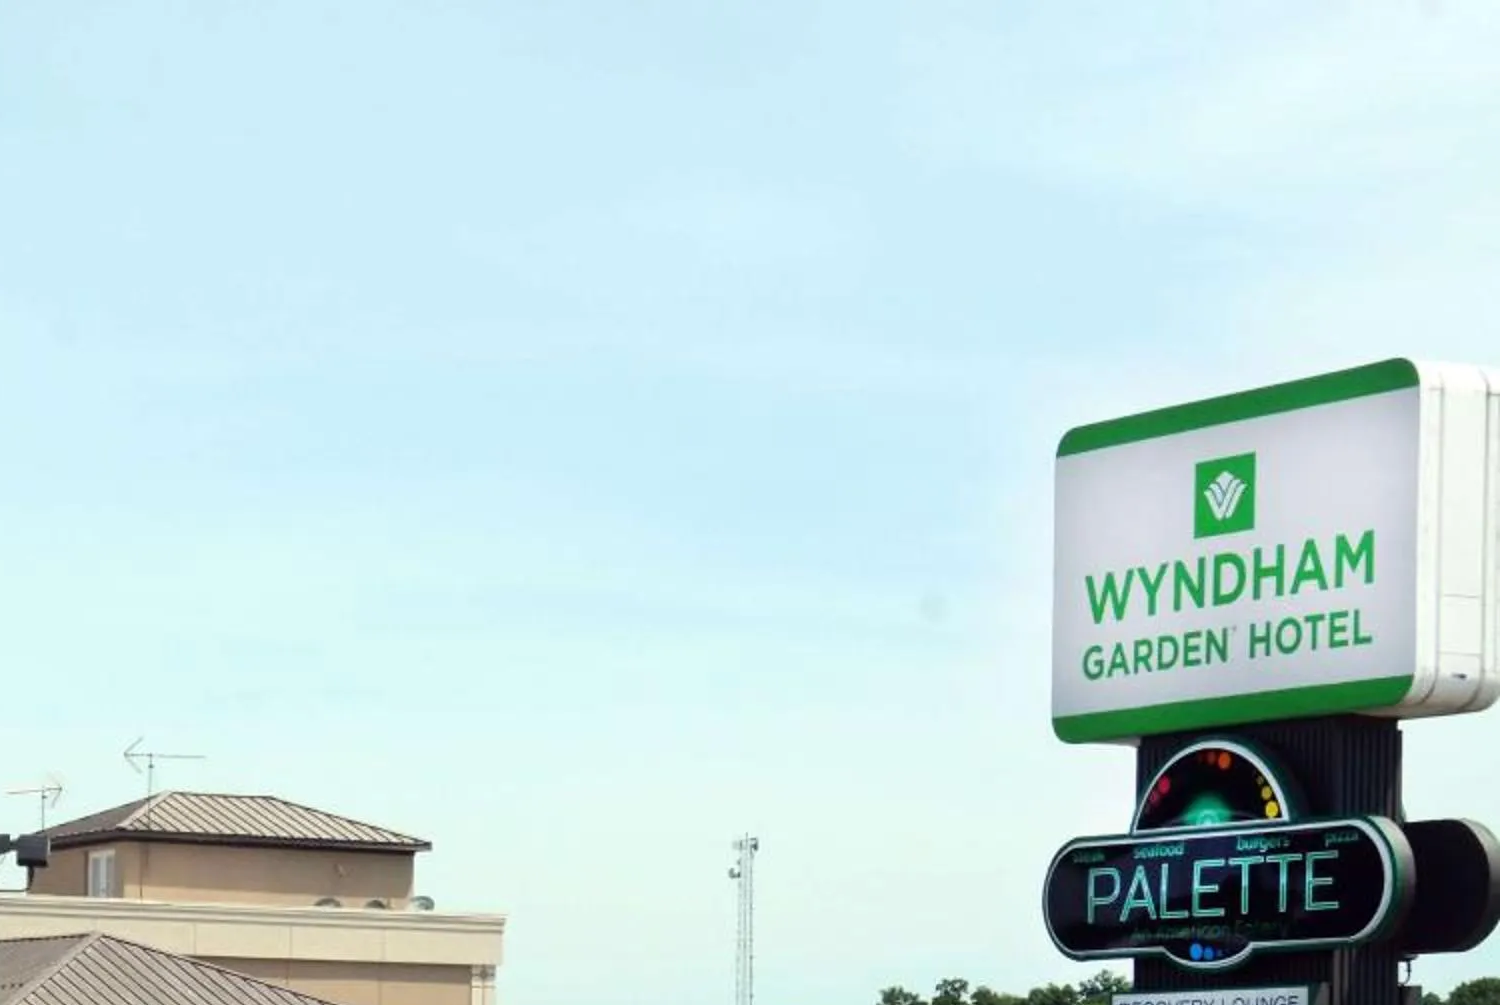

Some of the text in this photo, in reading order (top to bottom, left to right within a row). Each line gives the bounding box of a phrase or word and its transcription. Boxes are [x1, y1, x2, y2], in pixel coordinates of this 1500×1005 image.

[1084, 529, 1375, 625] WYNDHAM
[1082, 609, 1373, 681] GARDEN HOTEL
[1133, 842, 1185, 860] seafood
[1236, 834, 1290, 853] burgers
[1087, 850, 1339, 924] PALETTE
